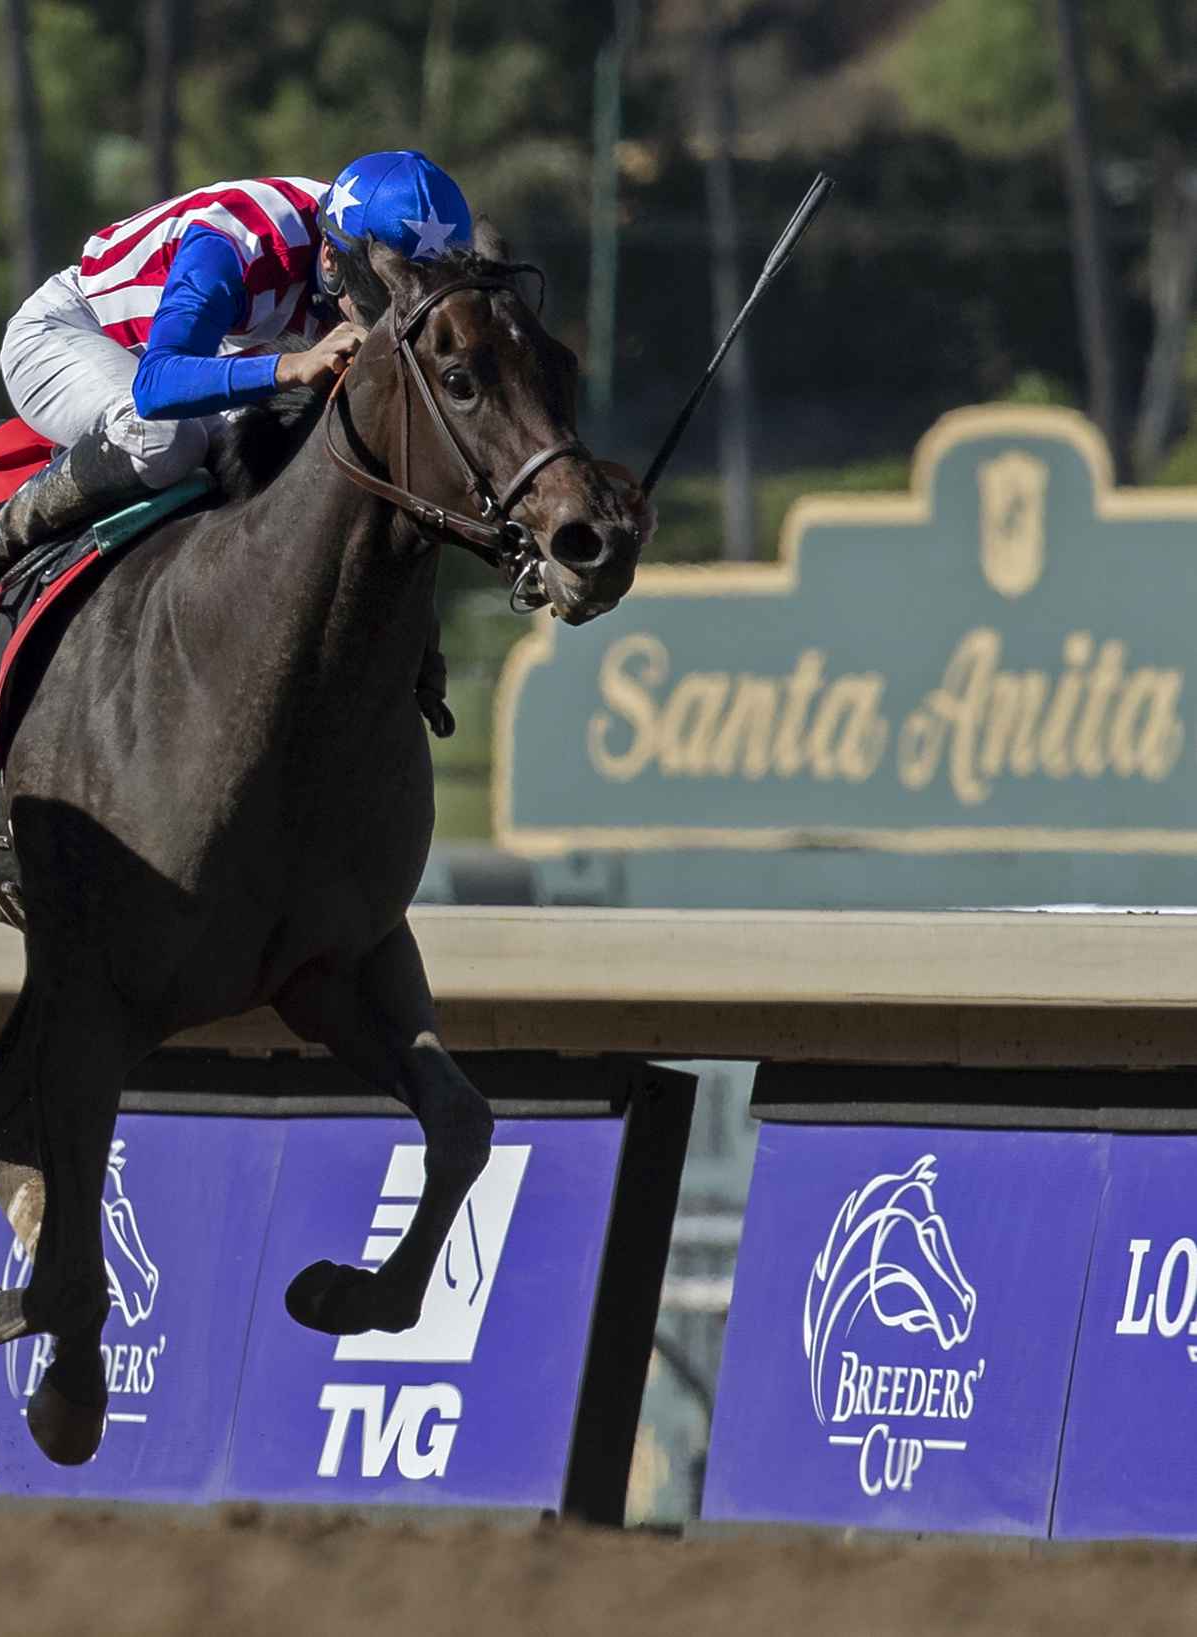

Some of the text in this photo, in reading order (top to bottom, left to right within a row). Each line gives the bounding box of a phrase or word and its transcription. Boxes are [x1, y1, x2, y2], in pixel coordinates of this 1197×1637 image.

[587, 626, 1185, 807] Santa Anita
[831, 1351, 986, 1423] BREEDERS'
[316, 1382, 464, 1480] TVG
[858, 1423, 924, 1497] CUP
